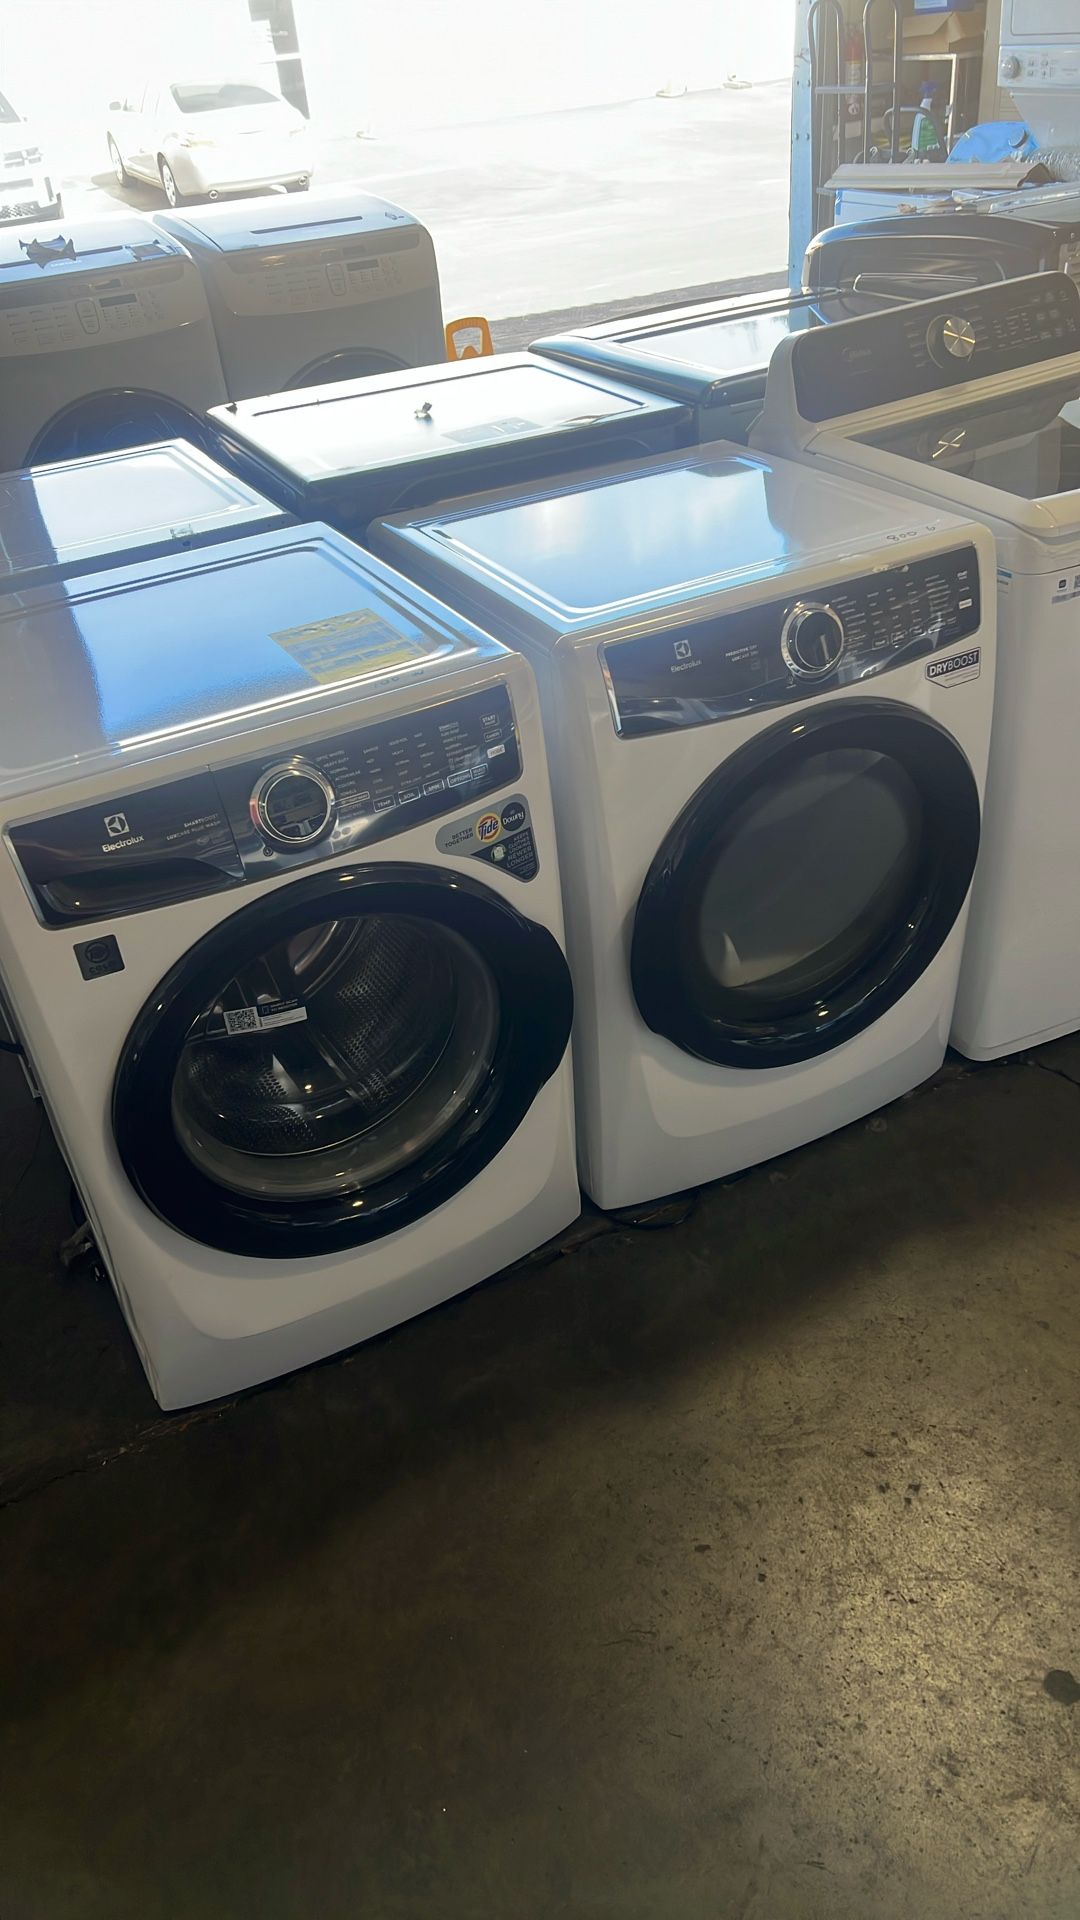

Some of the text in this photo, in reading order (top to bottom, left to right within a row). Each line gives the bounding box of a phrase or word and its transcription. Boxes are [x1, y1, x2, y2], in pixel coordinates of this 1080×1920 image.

[670, 659, 703, 673] Electrolux
[929, 652, 978, 676] DRYBOOST
[502, 812, 524, 825] Downy
[451, 827, 473, 840] BETTER
[478, 820, 499, 841] Tide
[101, 835, 145, 853] Electrolux
[445, 833, 474, 848] TOGETHER
[506, 852, 534, 868] LONGER
[507, 846, 532, 861] NEWER
